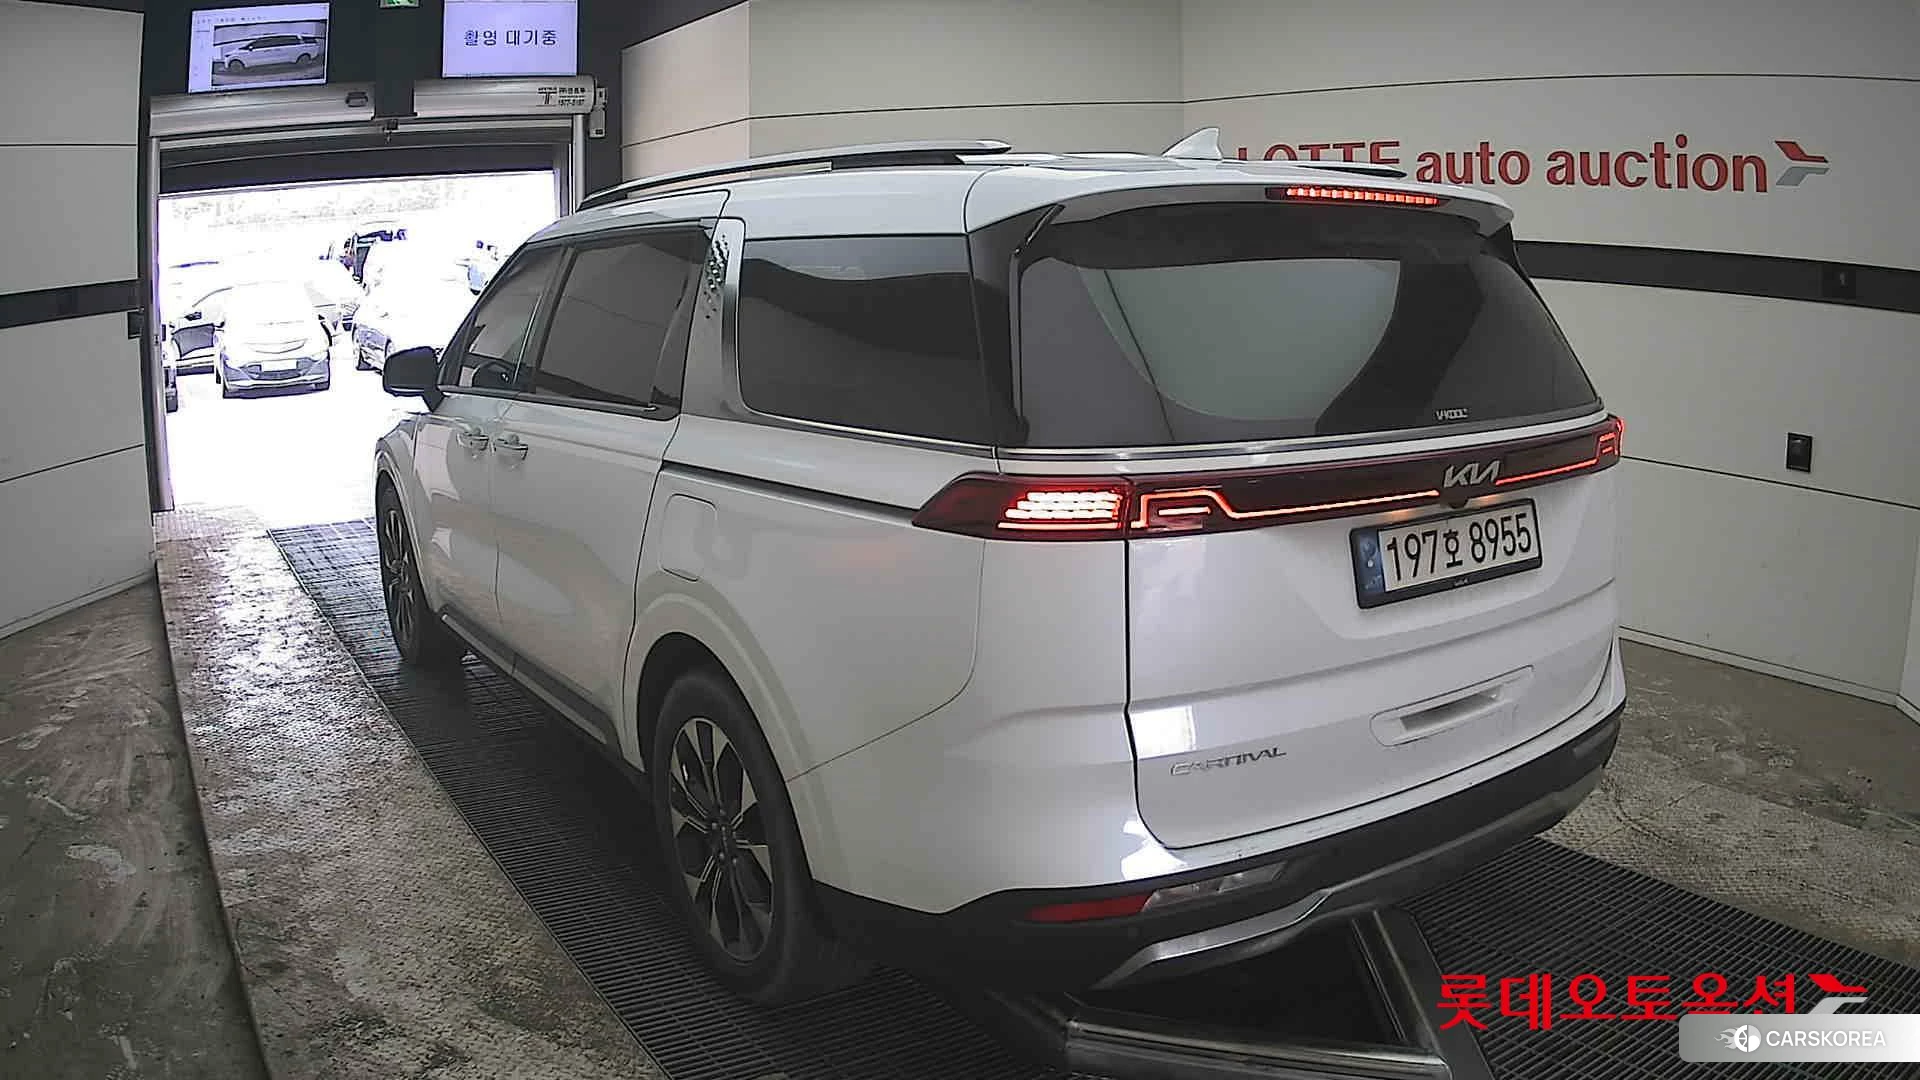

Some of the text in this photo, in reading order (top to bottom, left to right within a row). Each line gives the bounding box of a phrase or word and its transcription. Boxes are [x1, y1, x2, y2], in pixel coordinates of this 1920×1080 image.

[463, 29, 557, 47] 촬영 대기중
[1415, 141, 1531, 185] auto
[1546, 134, 1768, 193] auction
[1443, 460, 1501, 488] KIA
[1386, 512, 1532, 582] 197호 8955
